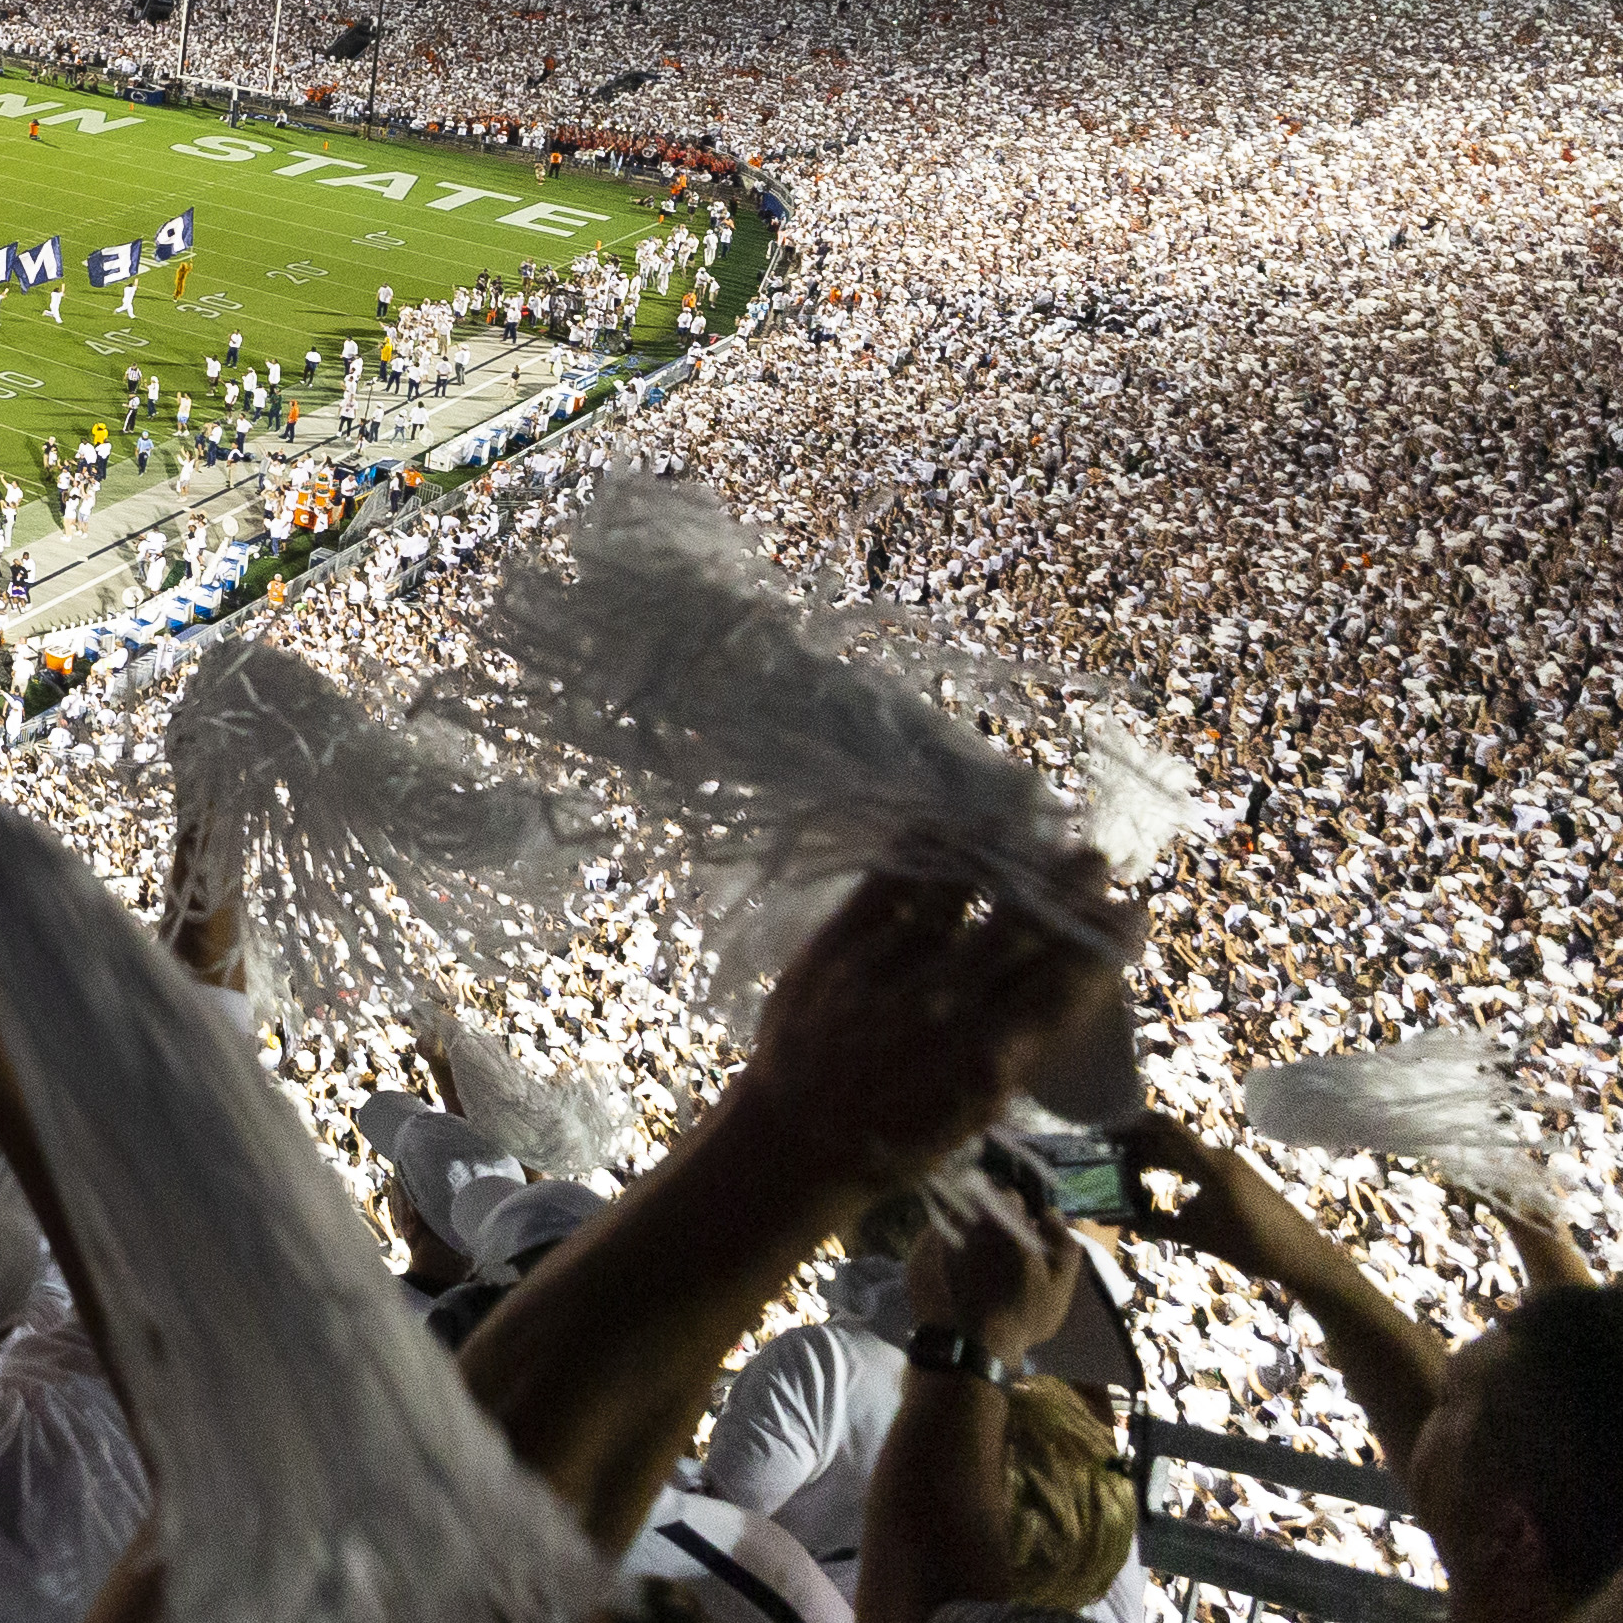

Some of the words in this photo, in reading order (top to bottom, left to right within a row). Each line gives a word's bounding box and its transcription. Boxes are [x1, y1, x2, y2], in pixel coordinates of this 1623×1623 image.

[170, 135, 611, 237] STATE
[266, 264, 329, 284] 20
[176, 297, 244, 320] 30
[85, 332, 148, 356] 40
[165, 643, 173, 653] 12
